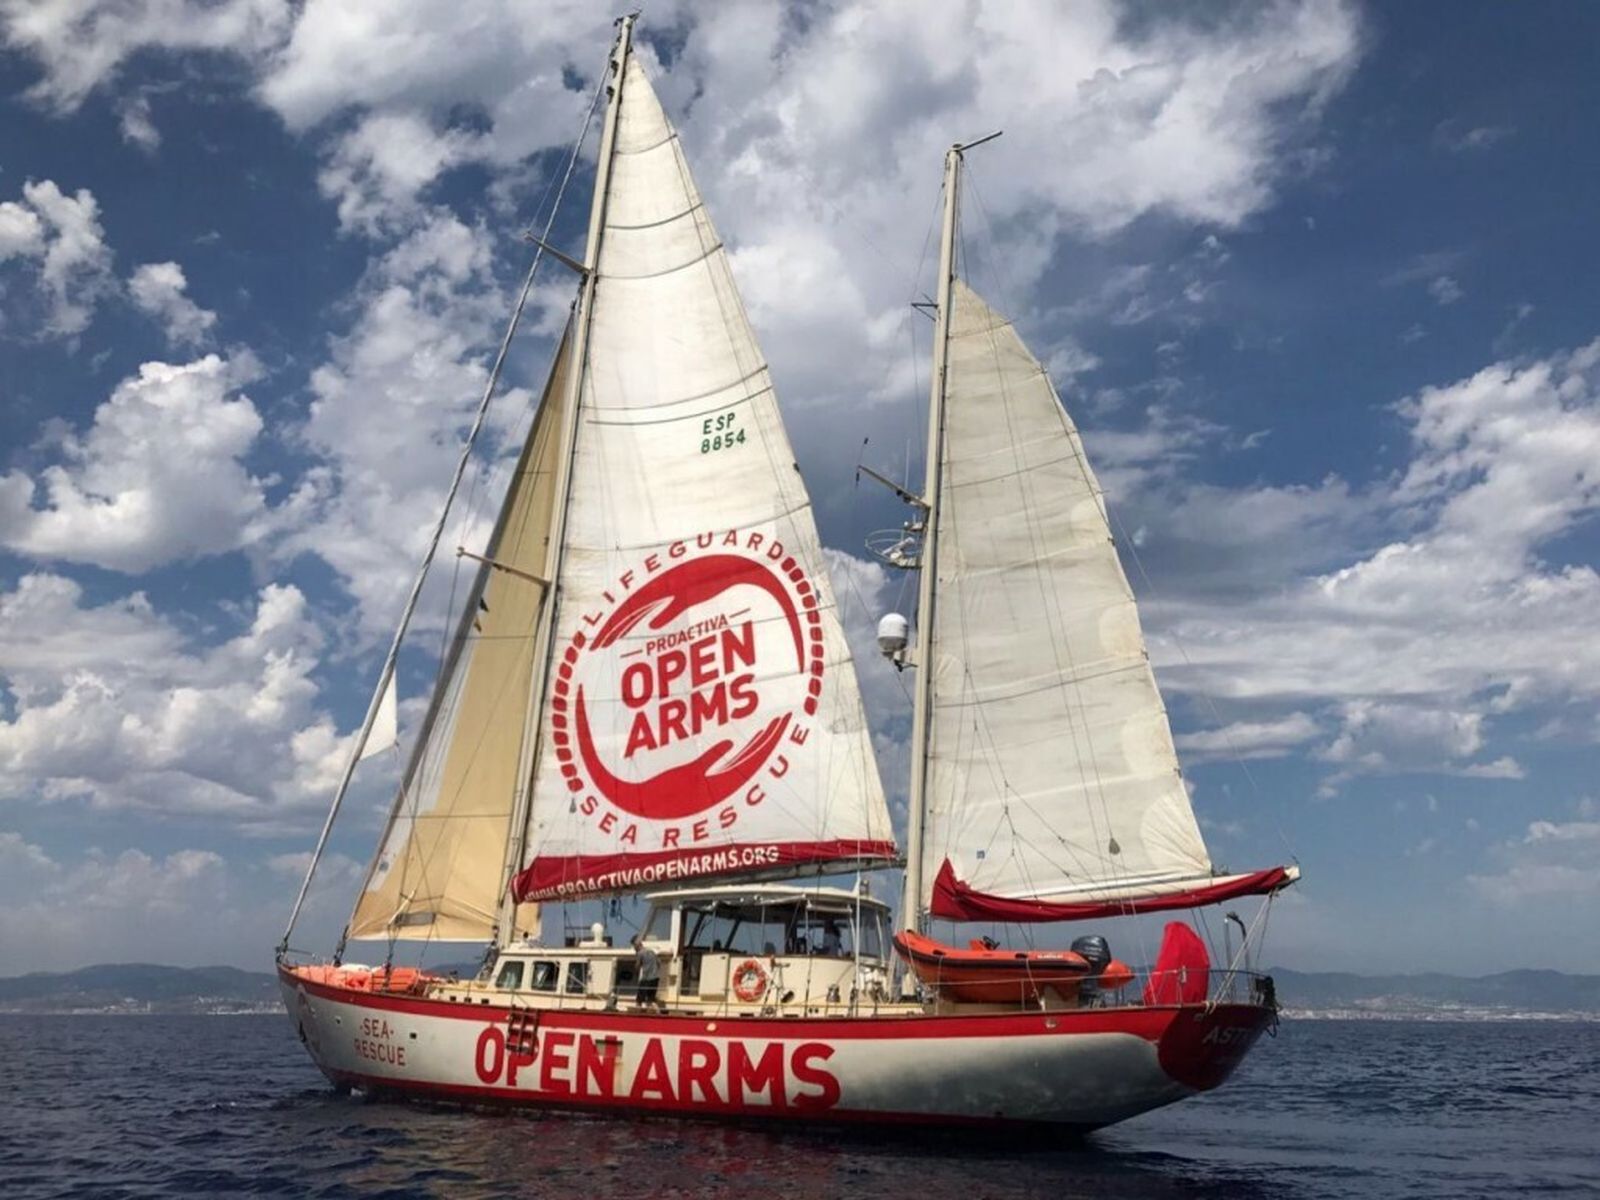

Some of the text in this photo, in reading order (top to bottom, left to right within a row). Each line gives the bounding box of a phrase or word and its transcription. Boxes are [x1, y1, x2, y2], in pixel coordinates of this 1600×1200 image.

[701, 428, 746, 454] 8854
[703, 412, 735, 435] ESP
[583, 529, 785, 627] LIFEGUARD
[621, 620, 756, 708] OPEN
[646, 613, 729, 656] PROACTIVA
[624, 673, 759, 759] ARMS
[581, 723, 810, 848] SEA RESCUE
[354, 1038, 406, 1066] RESCUE
[475, 1026, 841, 1112] OPEN ARMS
